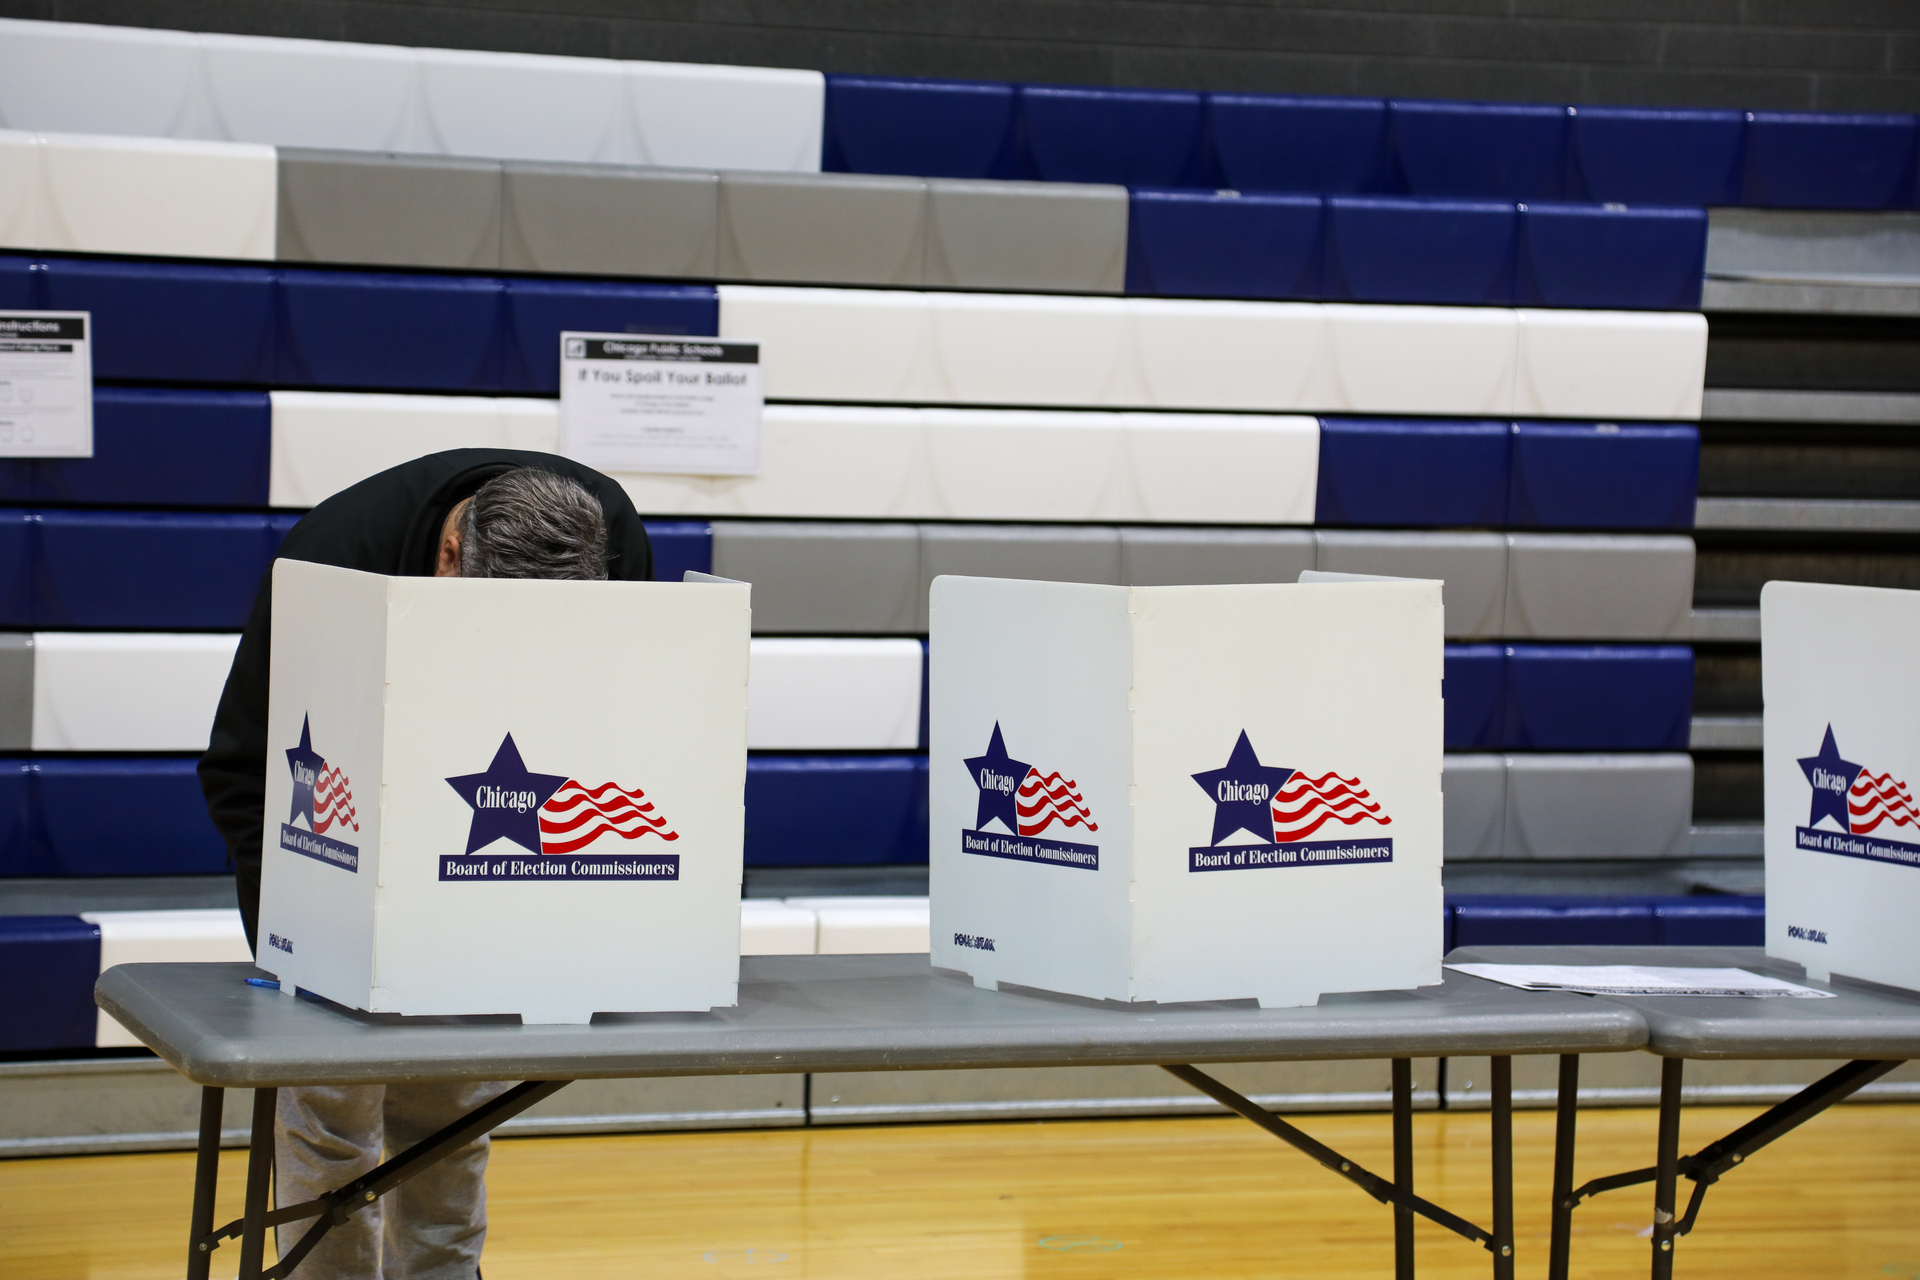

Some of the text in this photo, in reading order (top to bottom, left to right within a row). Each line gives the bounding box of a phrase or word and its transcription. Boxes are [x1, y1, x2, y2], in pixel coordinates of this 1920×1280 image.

[0, 320, 60, 331] nstructions
[602, 341, 724, 357] Chicago Public Schools
[578, 368, 748, 386] If You Spoil Your Ballot
[293, 759, 315, 791] Chicago
[979, 768, 1015, 796] Chicago
[1812, 767, 1847, 796] Chicago
[475, 785, 537, 814] Chicago
[1217, 779, 1269, 805] Chicago
[282, 829, 357, 867] Board of Election Commissioners
[965, 835, 1096, 865] Board of Election Commissioners
[1194, 845, 1389, 867] Board of Election Commissioners
[1799, 831, 1920, 863] Board of Election Commissioner
[446, 860, 675, 876] Board of Election Commissioners
